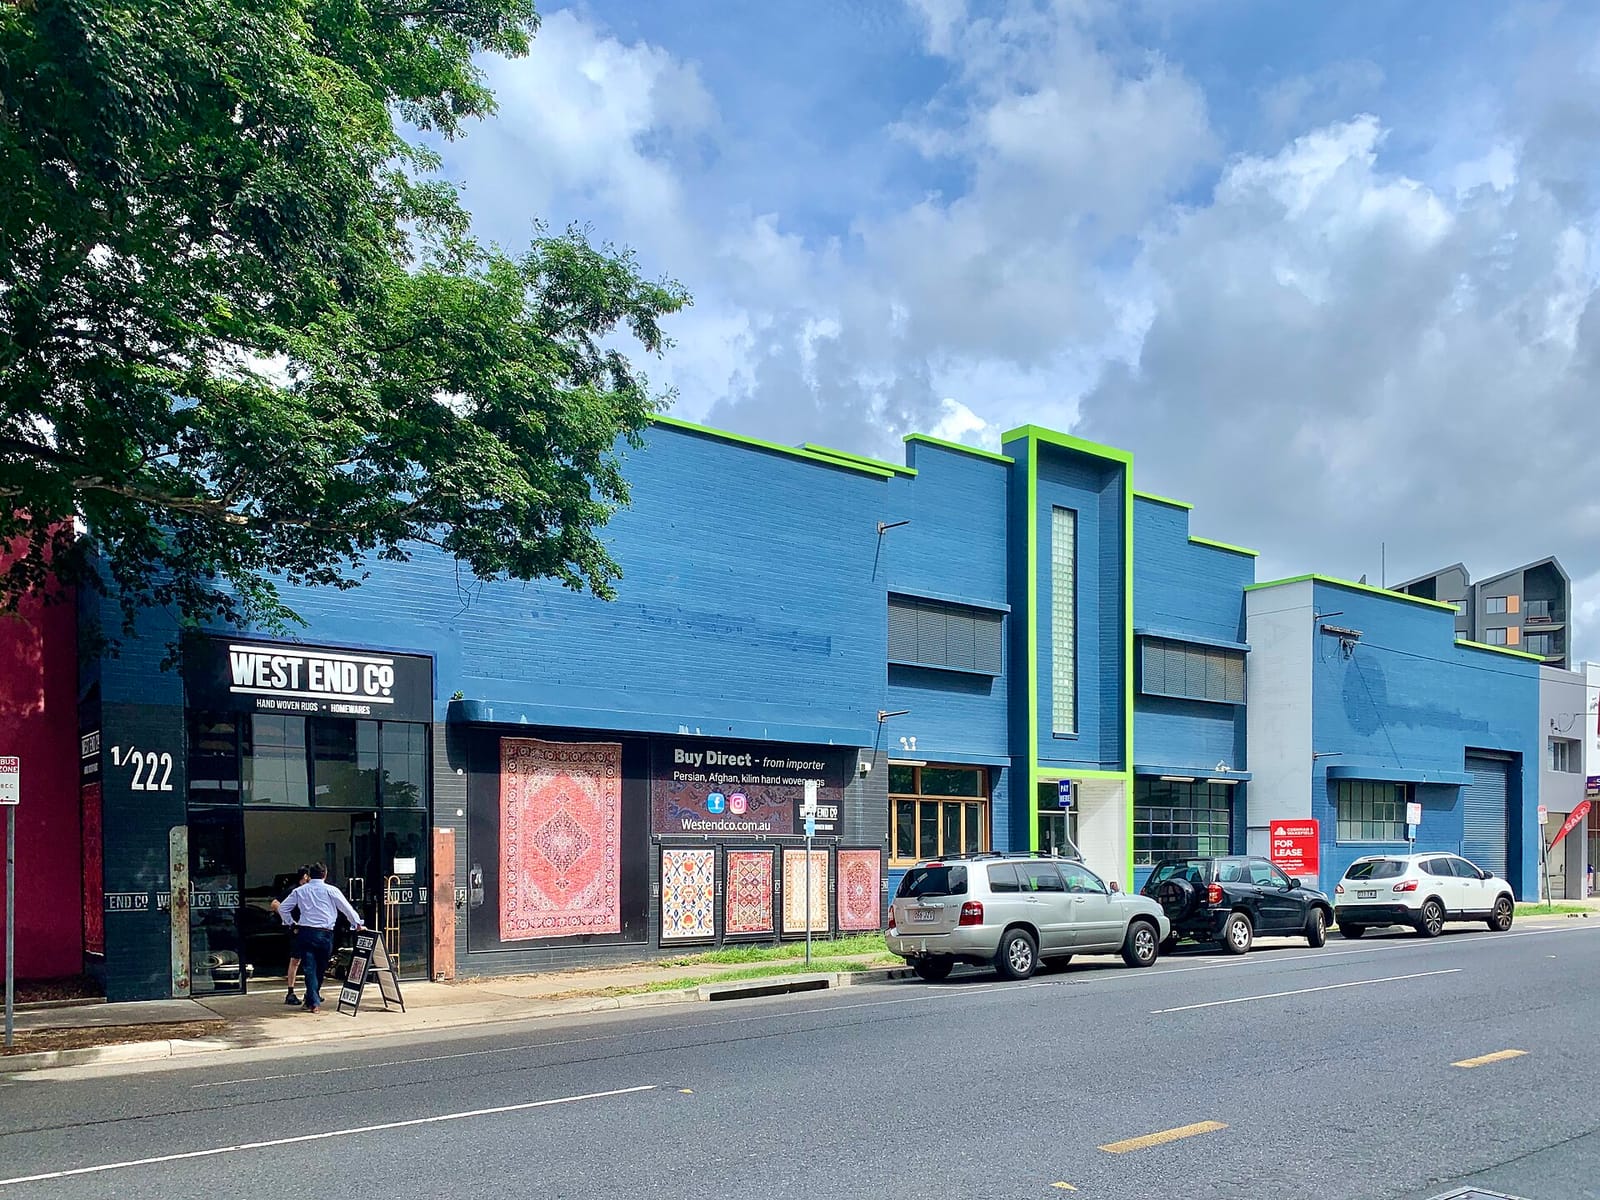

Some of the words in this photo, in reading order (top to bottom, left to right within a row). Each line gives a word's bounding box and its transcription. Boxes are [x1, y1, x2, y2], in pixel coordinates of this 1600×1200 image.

[229, 652, 303, 689] WEST
[308, 659, 358, 694] END
[256, 699, 275, 709] HAND
[276, 700, 300, 711] WOVEN
[301, 702, 318, 712] RUGS
[331, 704, 371, 715] HOMEWARES
[674, 749, 703, 767] Buy
[706, 751, 752, 766] Direct
[763, 757, 785, 769] from
[786, 758, 825, 771] importer
[111, 745, 173, 791] 1/222
[673, 771, 708, 783] Persian,
[709, 772, 740, 785] Afghan,
[741, 774, 760, 784] kilim
[761, 775, 781, 785] hand
[681, 818, 771, 832] Westendco.com.au
[1274, 840, 1293, 848] FOR
[1274, 848, 1303, 857] LEASE
[109, 895, 132, 909] END
[218, 894, 240, 906] WES
